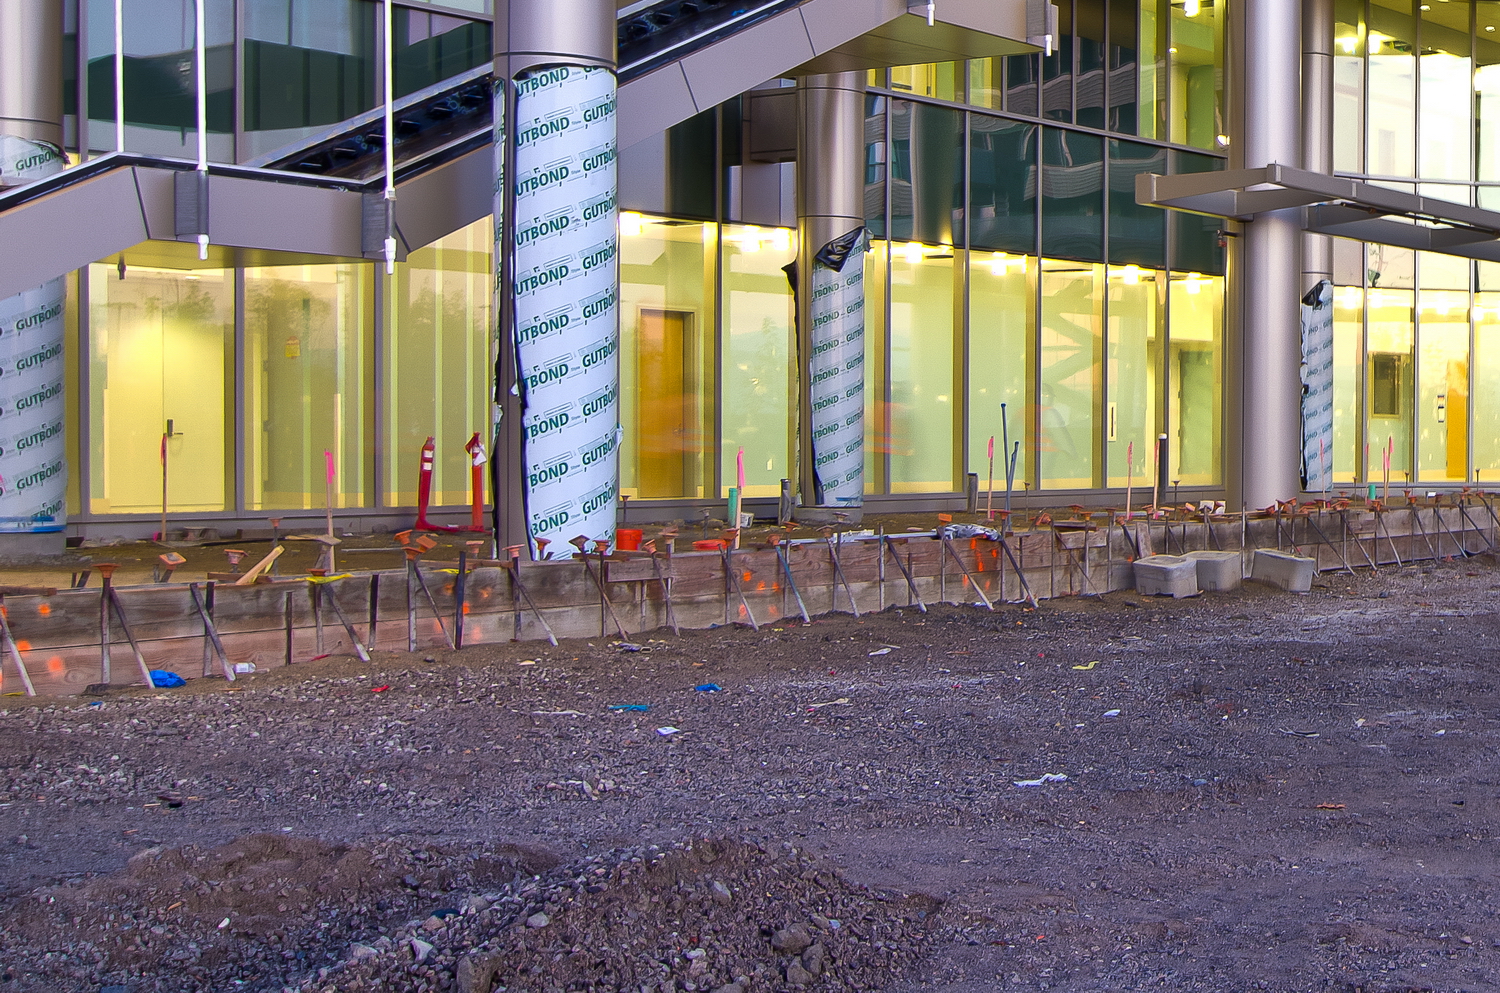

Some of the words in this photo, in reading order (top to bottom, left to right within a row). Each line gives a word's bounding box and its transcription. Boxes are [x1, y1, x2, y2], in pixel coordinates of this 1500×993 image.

[516, 67, 569, 97] UTBOND
[516, 117, 570, 146] UTBOND
[515, 166, 569, 196] UTBOND
[515, 216, 570, 246] UTBOND
[514, 265, 569, 295] UTBOND
[813, 283, 839, 298] TBOND
[16, 304, 61, 330] GUTBOND
[516, 314, 570, 344] UTBOND
[813, 311, 839, 327] TBOND
[16, 344, 61, 370] GUTBOND
[812, 339, 839, 355] TBOND
[522, 364, 569, 389] TBOND
[16, 382, 61, 409] GUTBOND
[813, 395, 839, 411] TBOND
[16, 422, 62, 450] GUTBOND
[813, 423, 839, 439] TBOND
[816, 451, 839, 466] BOND
[16, 461, 62, 489] GUTBOND
[529, 462, 569, 487] BOND
[532, 511, 569, 535] BOND
